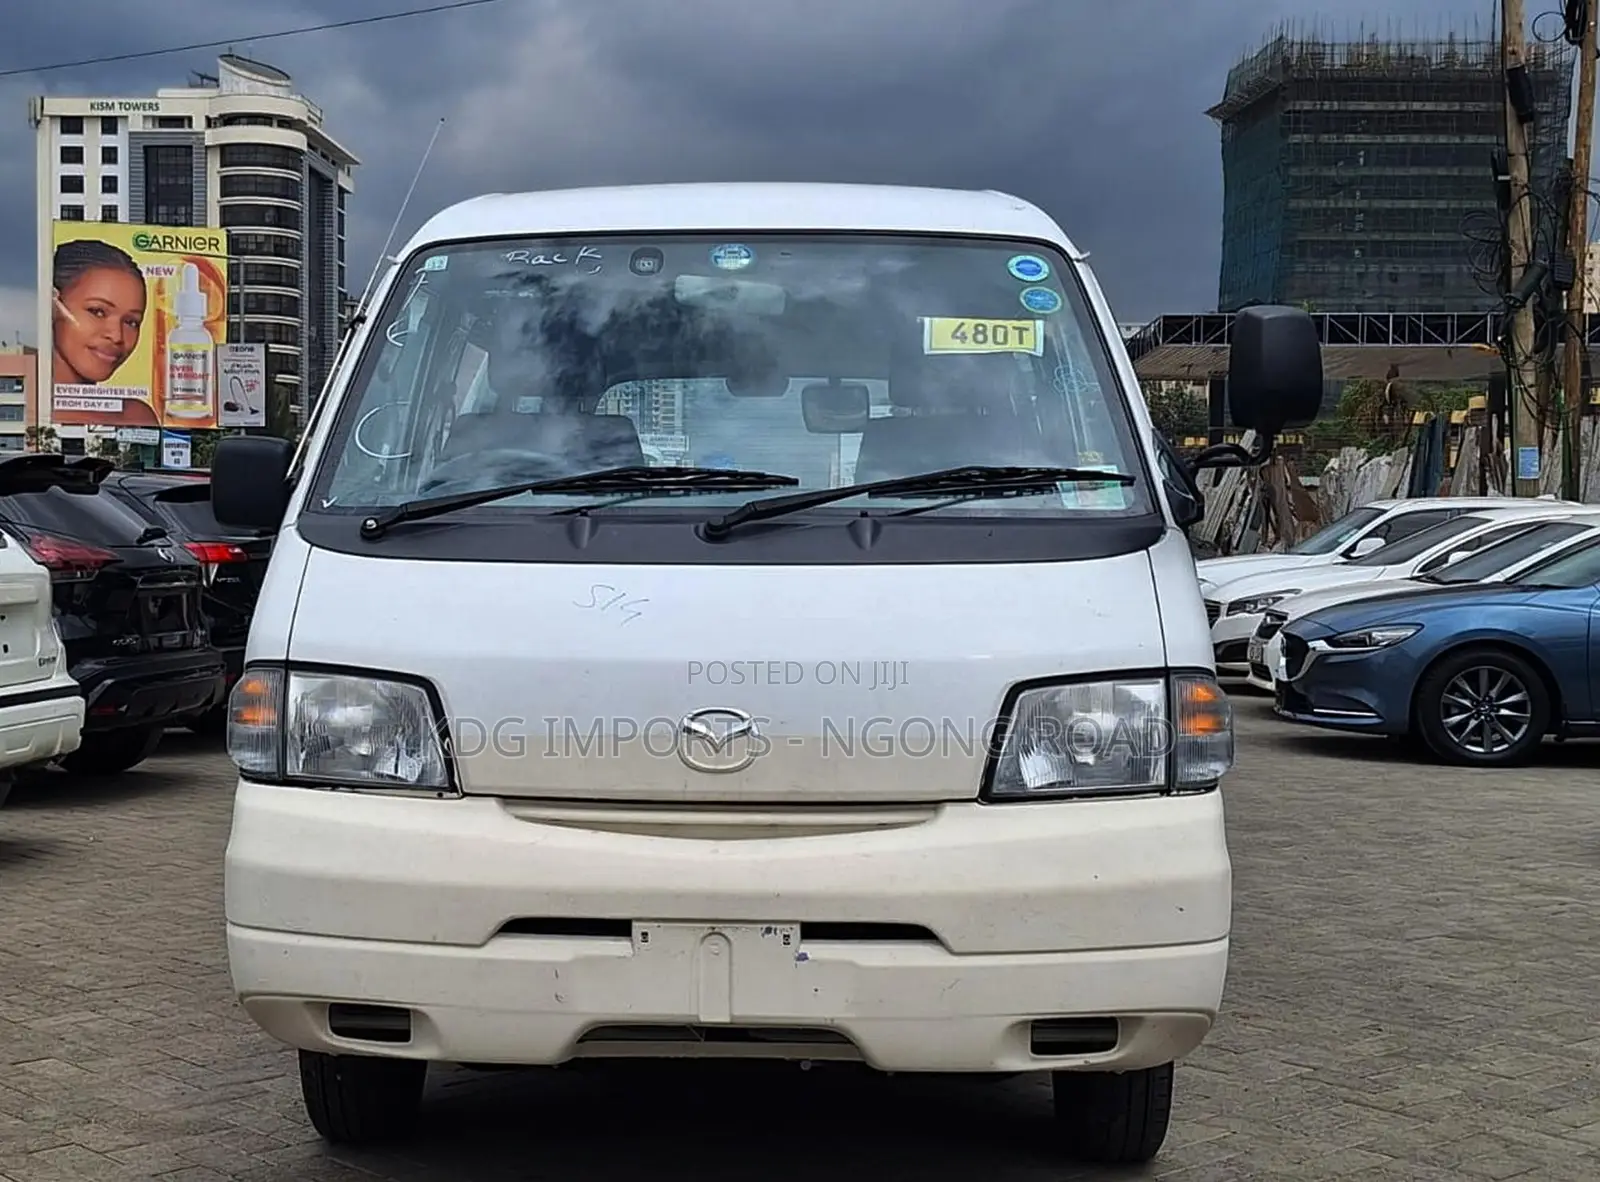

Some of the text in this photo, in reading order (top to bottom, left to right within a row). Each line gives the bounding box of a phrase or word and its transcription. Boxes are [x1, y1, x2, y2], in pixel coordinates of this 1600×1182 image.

[89, 102, 160, 111] KISM TOWERS
[133, 233, 220, 251] GARNIER
[145, 266, 174, 276] NEW
[950, 322, 1030, 345] 480T
[56, 386, 148, 396] EVEN BRIGHTER SKIN
[56, 400, 82, 408] FROM
[84, 401, 102, 409] DAY
